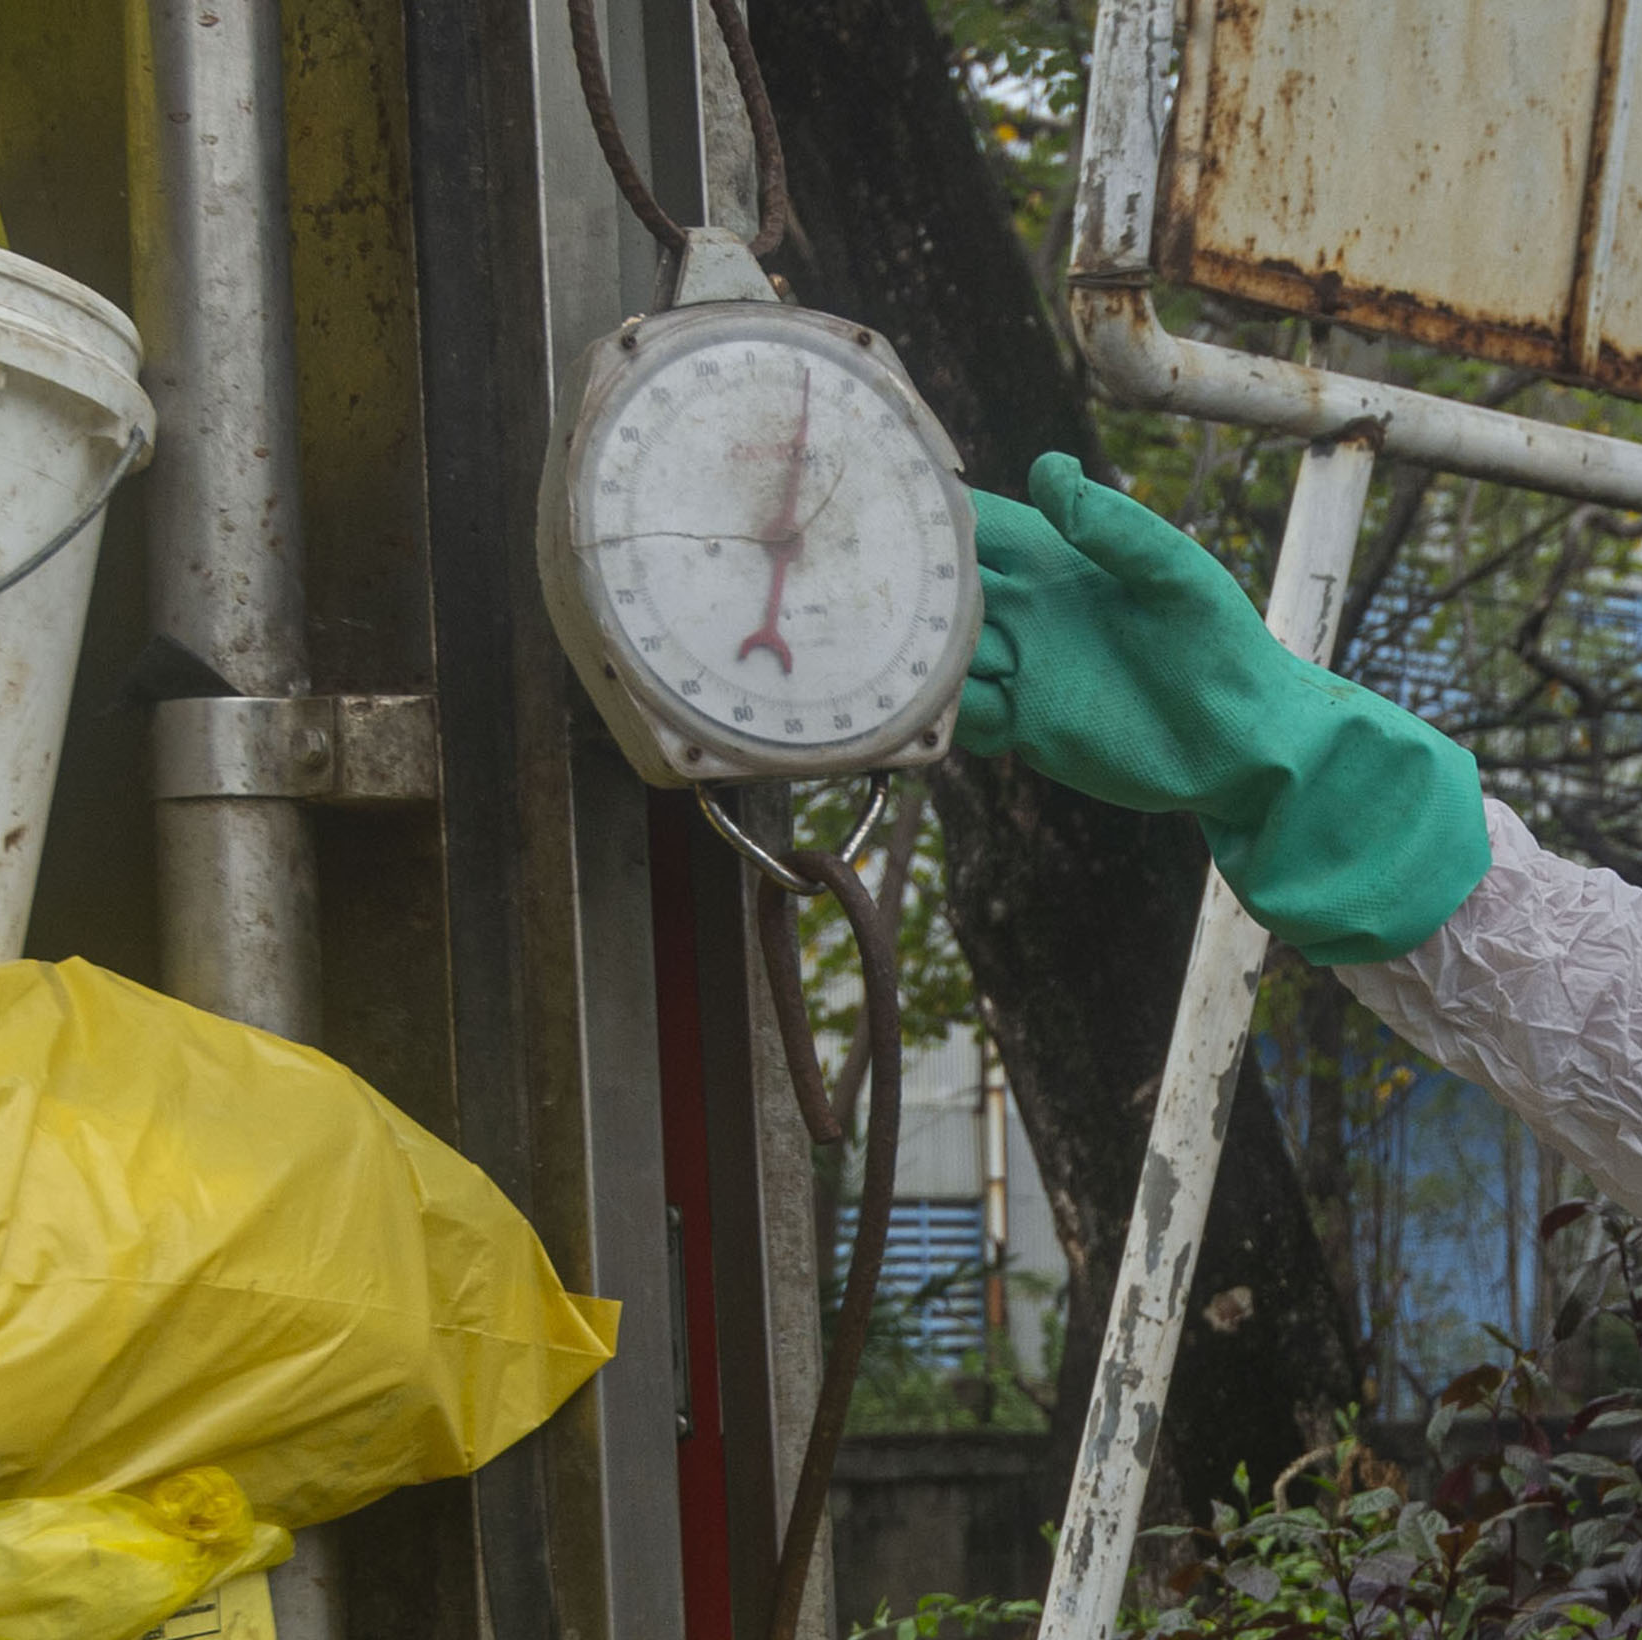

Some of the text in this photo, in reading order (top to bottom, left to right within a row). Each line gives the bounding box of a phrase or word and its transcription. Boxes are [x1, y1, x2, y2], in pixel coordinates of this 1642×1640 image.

[695, 360, 720, 378] 100
[619, 425, 640, 443] 90
[935, 563, 955, 580] 30
[615, 588, 636, 605] 75
[928, 615, 948, 633] 35
[640, 636, 661, 653] 70
[910, 660, 928, 677] 40
